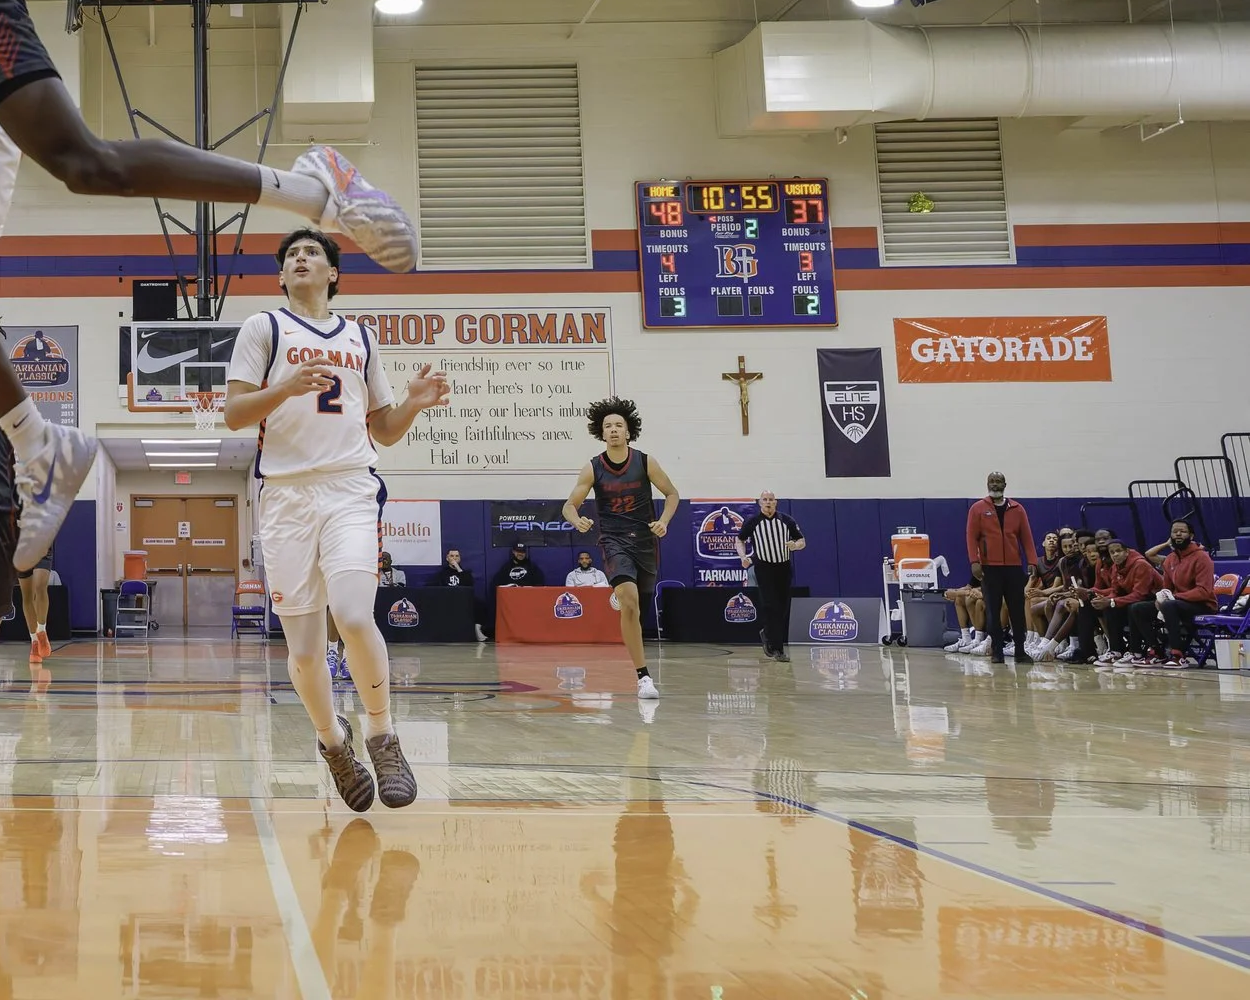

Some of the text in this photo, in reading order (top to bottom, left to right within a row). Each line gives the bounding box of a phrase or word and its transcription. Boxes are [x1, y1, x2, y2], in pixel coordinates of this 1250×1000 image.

[649, 186, 675, 197] HOME
[784, 183, 822, 196] VISITOR
[701, 186, 773, 210] 10:55
[650, 202, 683, 225] 48
[793, 200, 824, 224] 37
[660, 229, 688, 238] BONUS
[710, 223, 742, 232] PERIOD
[745, 219, 757, 238] 2
[781, 228, 810, 237] BONUS
[646, 244, 689, 253] TIMEOUTS
[783, 242, 826, 251] TIMEOUTS
[661, 254, 675, 273] 4
[800, 252, 813, 271] 3
[658, 274, 679, 283] LEFT
[797, 272, 817, 281] LEFT
[658, 287, 685, 296] FOULS
[710, 286, 775, 295] PLAYER FOULS
[792, 285, 819, 294] FOULS
[672, 297, 685, 316] 3
[806, 295, 819, 315] 2
[355, 312, 607, 346] SHOP GORMAN
[910, 335, 1094, 364] GATORADE
[286, 346, 363, 374] GORMAN
[393, 360, 406, 372] to
[439, 357, 500, 376] friendship
[505, 362, 532, 372] ever
[537, 361, 553, 372] so
[560, 359, 586, 371] true
[13, 363, 67, 373] ARKANIAN
[16, 372, 57, 381] CLASSIC
[316, 374, 344, 415] 2
[487, 379, 524, 395] here's
[531, 382, 543, 395] to
[547, 383, 572, 399] you.
[834, 392, 871, 403] ELITE
[459, 408, 483, 422] may
[489, 407, 509, 418] our
[514, 402, 553, 418] hearts
[842, 405, 866, 422] HS
[407, 425, 573, 446] pledging faithfulness anew.
[430, 448, 510, 469] Hail to you!
[611, 495, 637, 513] 22
[380, 522, 431, 537] dballín
[499, 521, 576, 531] PANGO
[698, 569, 748, 582] TARKANIA
[271, 592, 283, 603] G
[812, 623, 856, 631] TARKANIAN
[818, 628, 848, 637] CLASSIC
